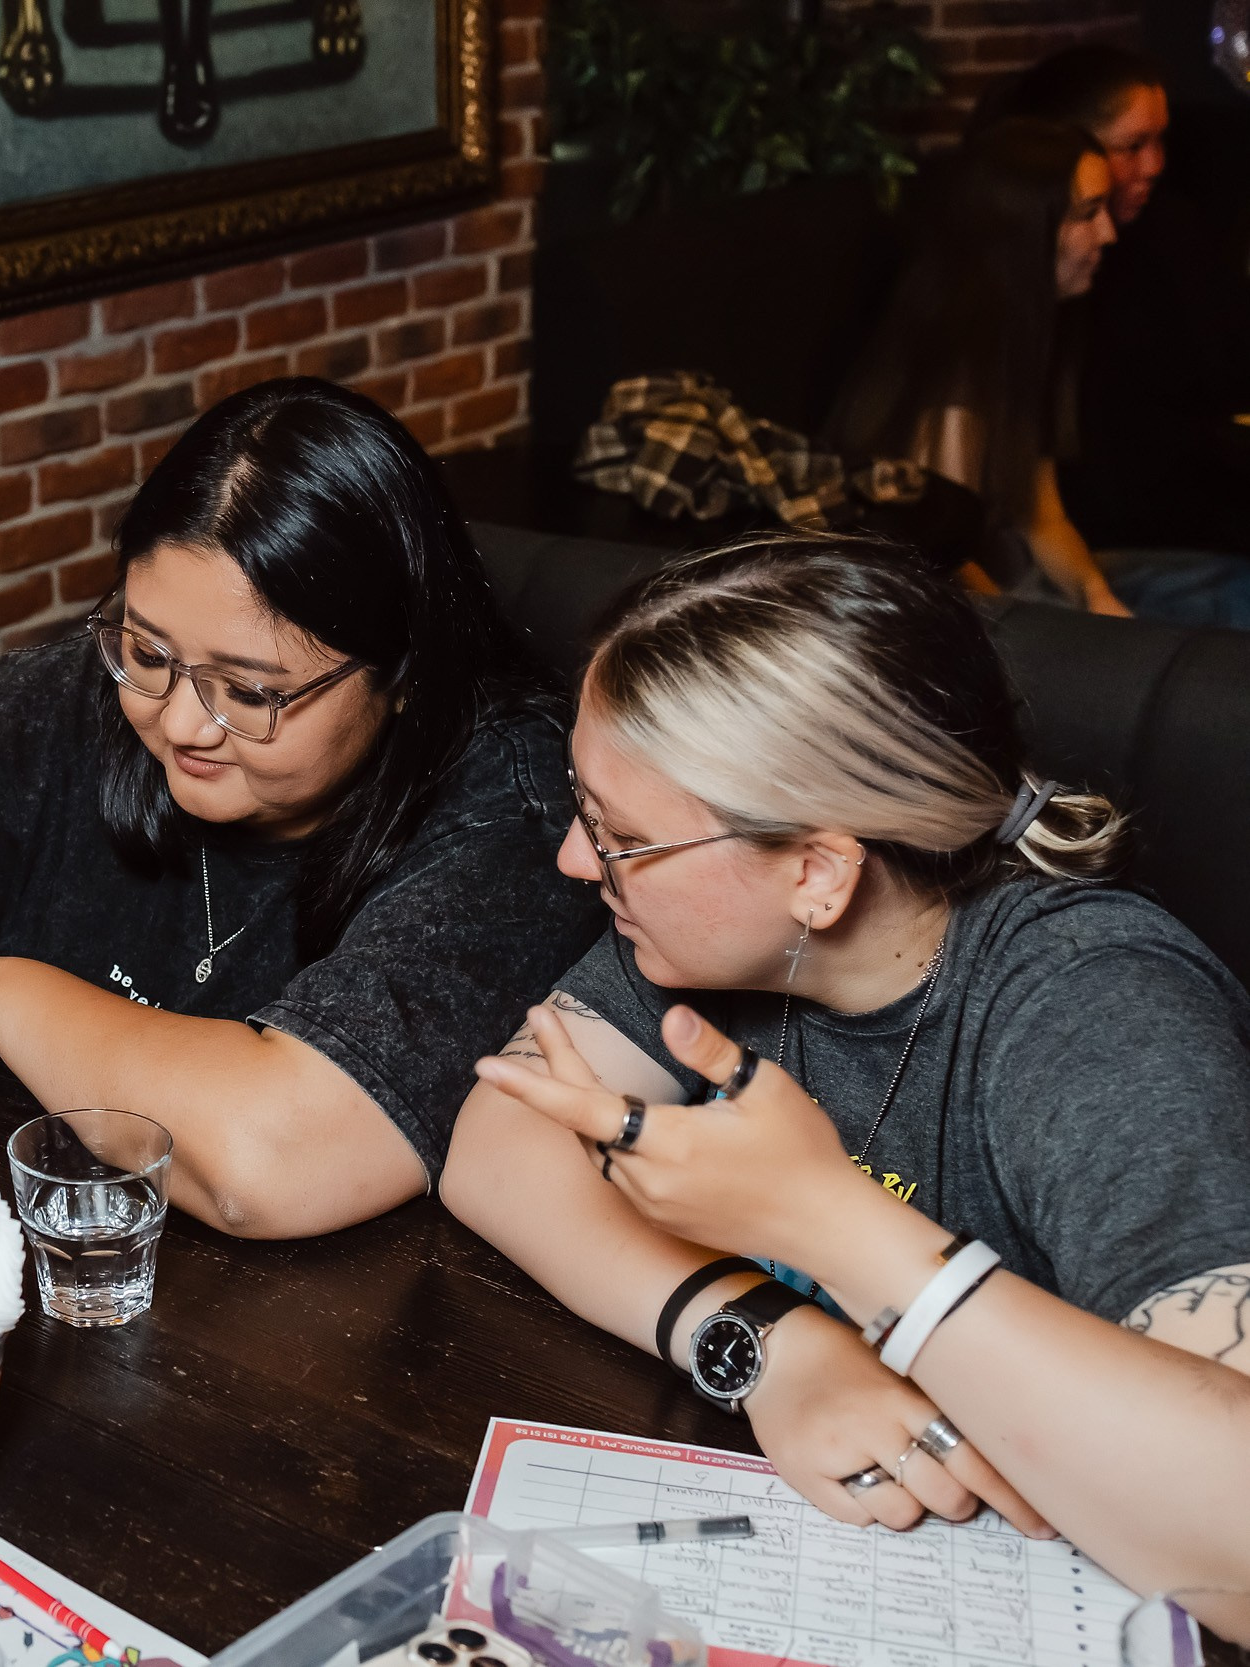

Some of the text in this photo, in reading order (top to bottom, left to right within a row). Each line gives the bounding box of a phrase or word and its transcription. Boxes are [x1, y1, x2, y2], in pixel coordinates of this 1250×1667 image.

[514, 1427, 529, 1435] 58
[530, 1429, 541, 1437] 51
[542, 1431, 558, 1440] 151
[559, 1433, 578, 1443] 778
[579, 1436, 588, 1444] 8
[598, 1439, 682, 1458] @WOWQUIZ_PVL
